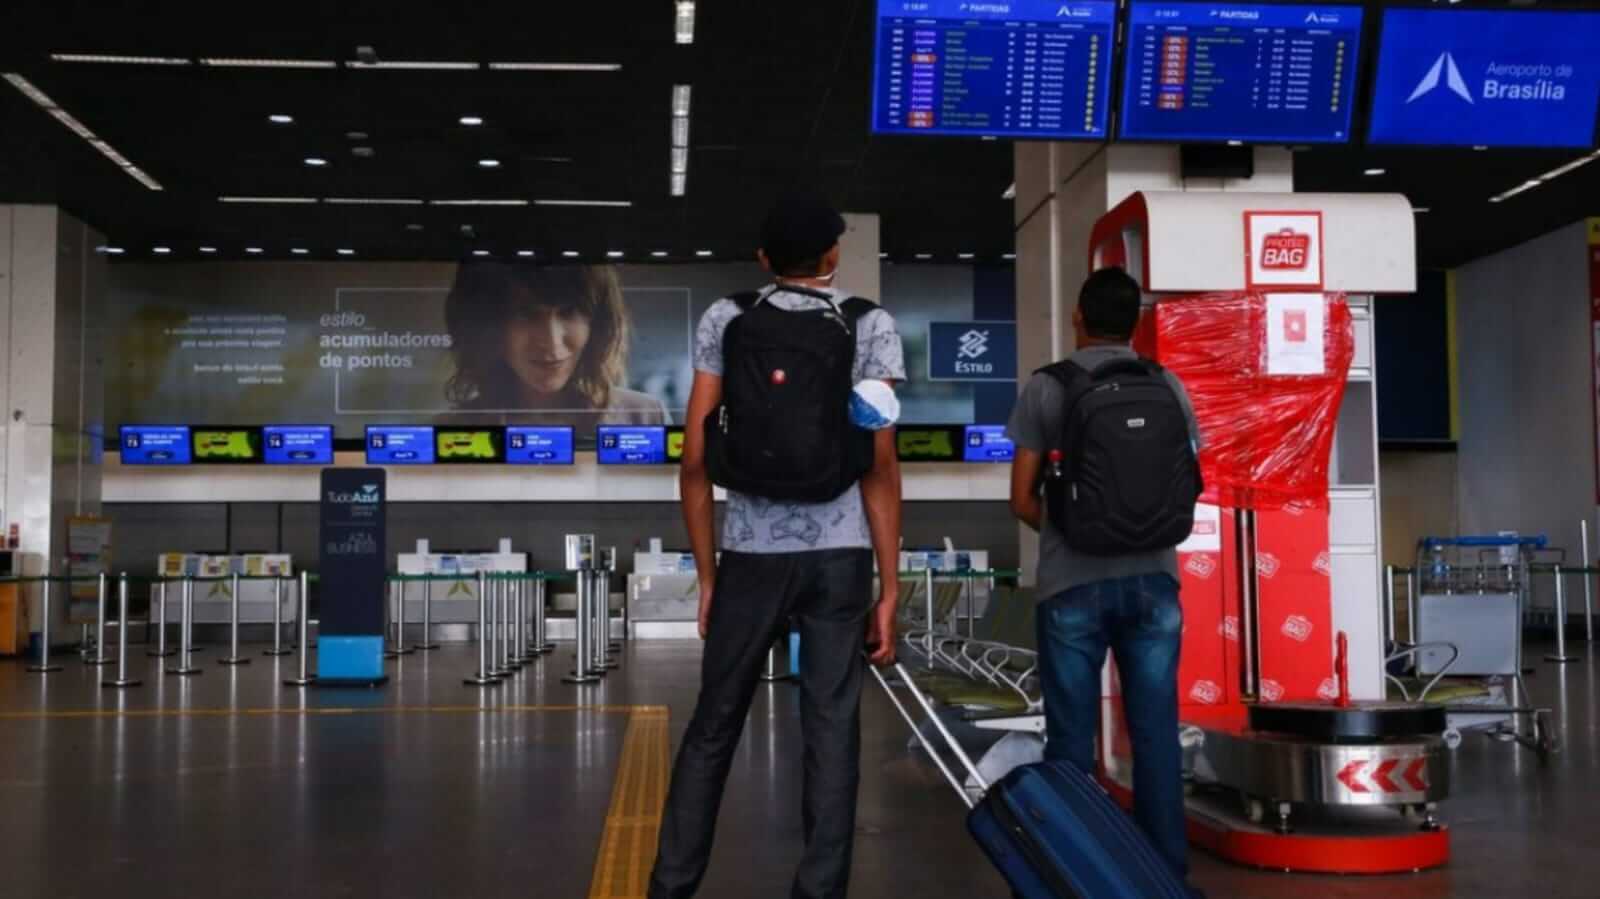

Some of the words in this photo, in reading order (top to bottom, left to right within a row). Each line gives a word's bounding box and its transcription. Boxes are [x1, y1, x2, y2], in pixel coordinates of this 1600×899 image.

[1486, 61, 1552, 78] Aeroporto
[1555, 63, 1573, 77] de
[1482, 79, 1566, 100] Brasília
[1263, 248, 1304, 265] BAG
[319, 331, 453, 348] acumuladores
[319, 352, 342, 369] de
[347, 352, 413, 371] pontos
